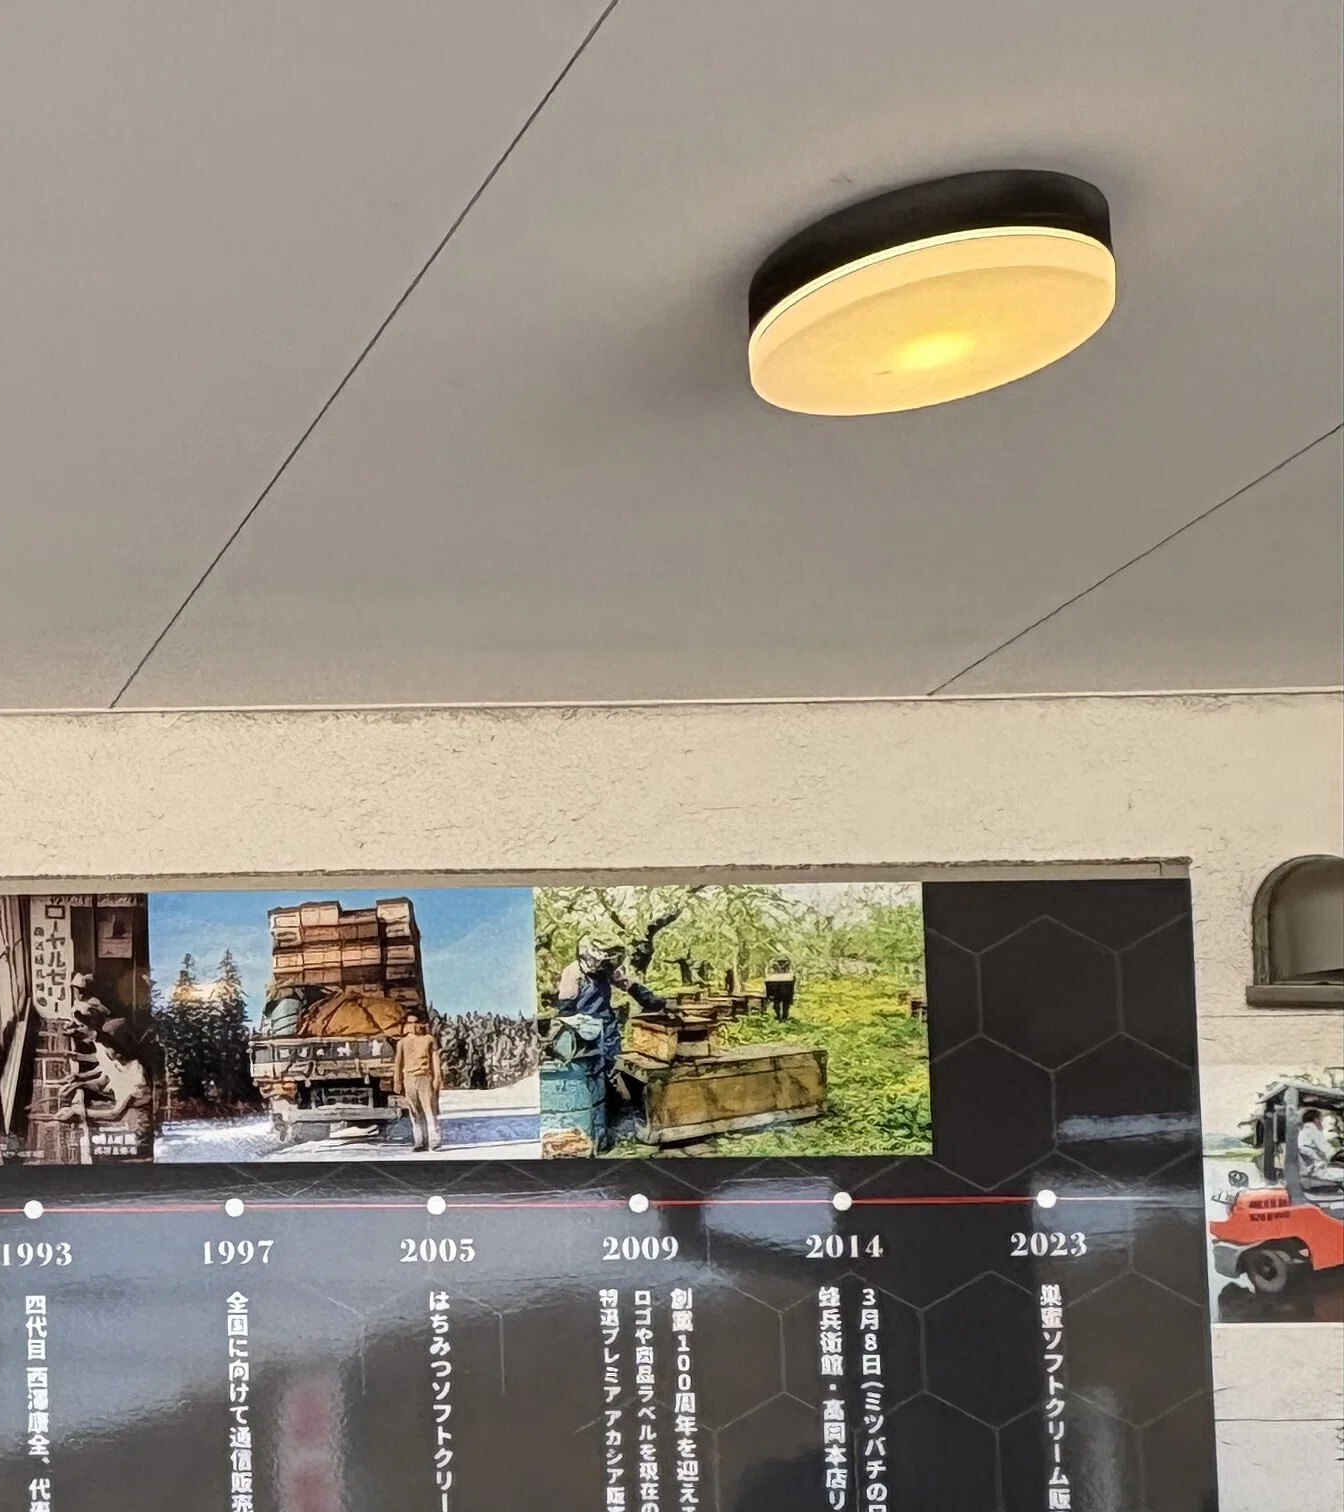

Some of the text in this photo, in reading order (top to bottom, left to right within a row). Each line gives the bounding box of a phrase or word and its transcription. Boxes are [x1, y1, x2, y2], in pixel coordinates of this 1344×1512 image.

[3, 1242, 71, 1266] 1993
[204, 1239, 273, 1264] 1997
[400, 1238, 475, 1262] 2005
[602, 1236, 678, 1260] 2009
[805, 1234, 883, 1258] 2014
[1010, 1231, 1087, 1256] 2023
[25, 1295, 47, 1360] 四代目
